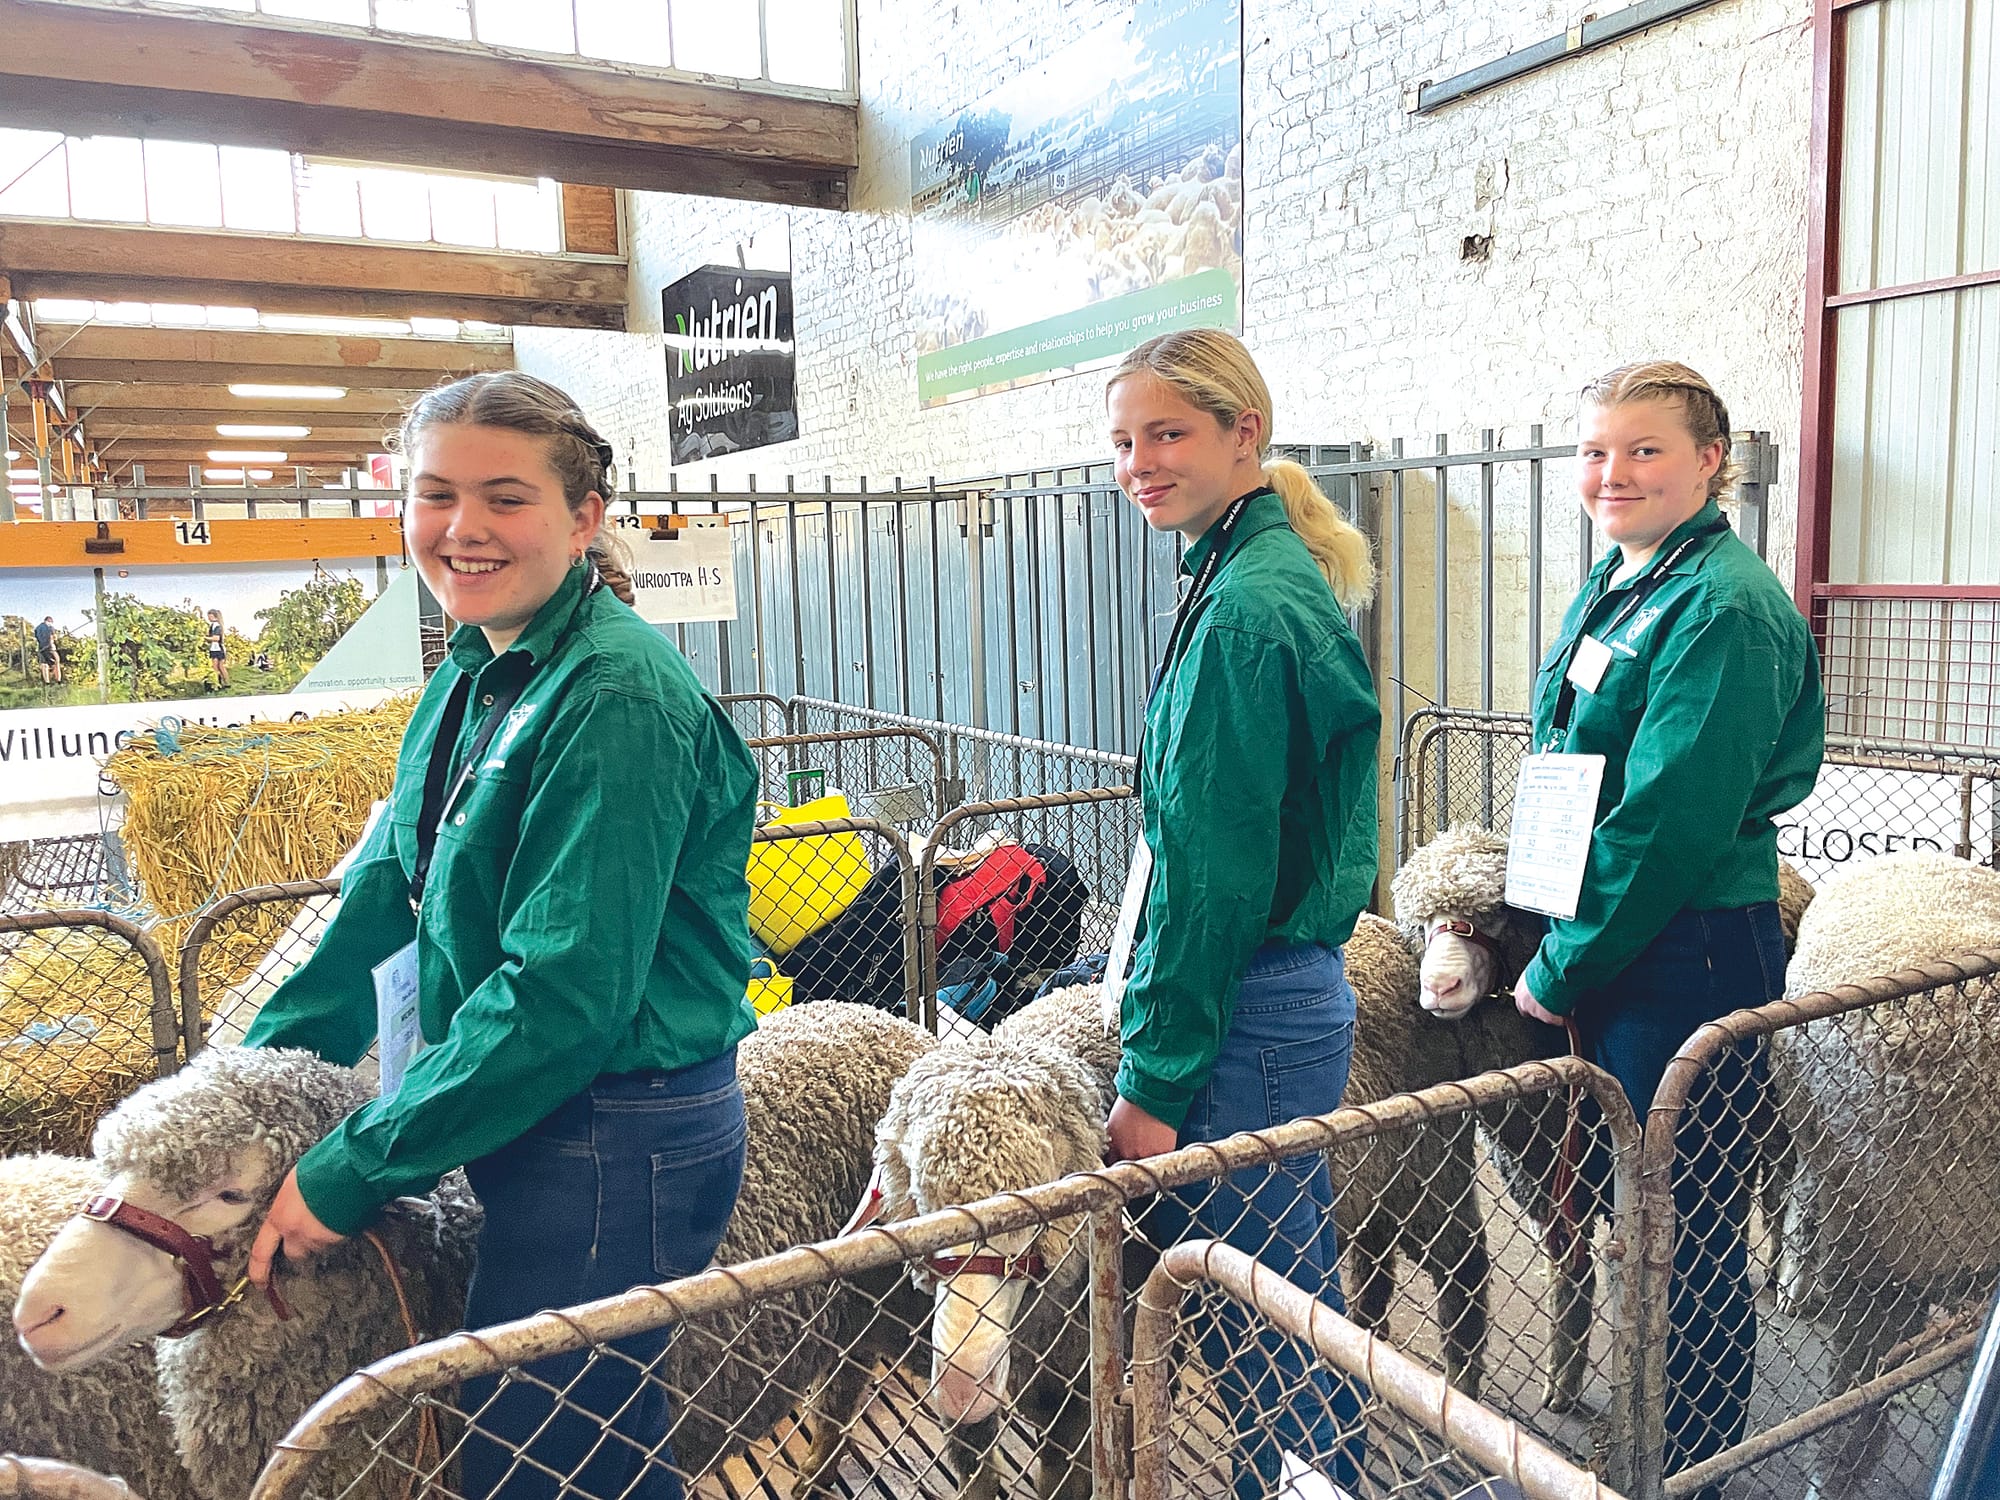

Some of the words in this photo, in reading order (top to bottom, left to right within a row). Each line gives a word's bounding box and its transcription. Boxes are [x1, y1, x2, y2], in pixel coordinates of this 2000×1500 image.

[920, 131, 964, 172] Nutrien
[1056, 174, 1066, 188] 96
[675, 278, 778, 379] Nutrien
[925, 371, 935, 383] We
[934, 368, 948, 380] have
[948, 364, 959, 377] the
[958, 360, 973, 376] right
[995, 346, 1025, 365] expertise
[1025, 340, 1038, 356] and
[1037, 328, 1086, 353] relationships
[1085, 327, 1095, 340] to
[1095, 321, 1114, 339] help
[1114, 319, 1130, 336] you
[1131, 312, 1155, 331] grow
[1155, 304, 1179, 325] your
[1179, 293, 1223, 315] business
[677, 394, 694, 434] Ag
[695, 380, 752, 422] Solutions
[176, 521, 209, 544] 14
